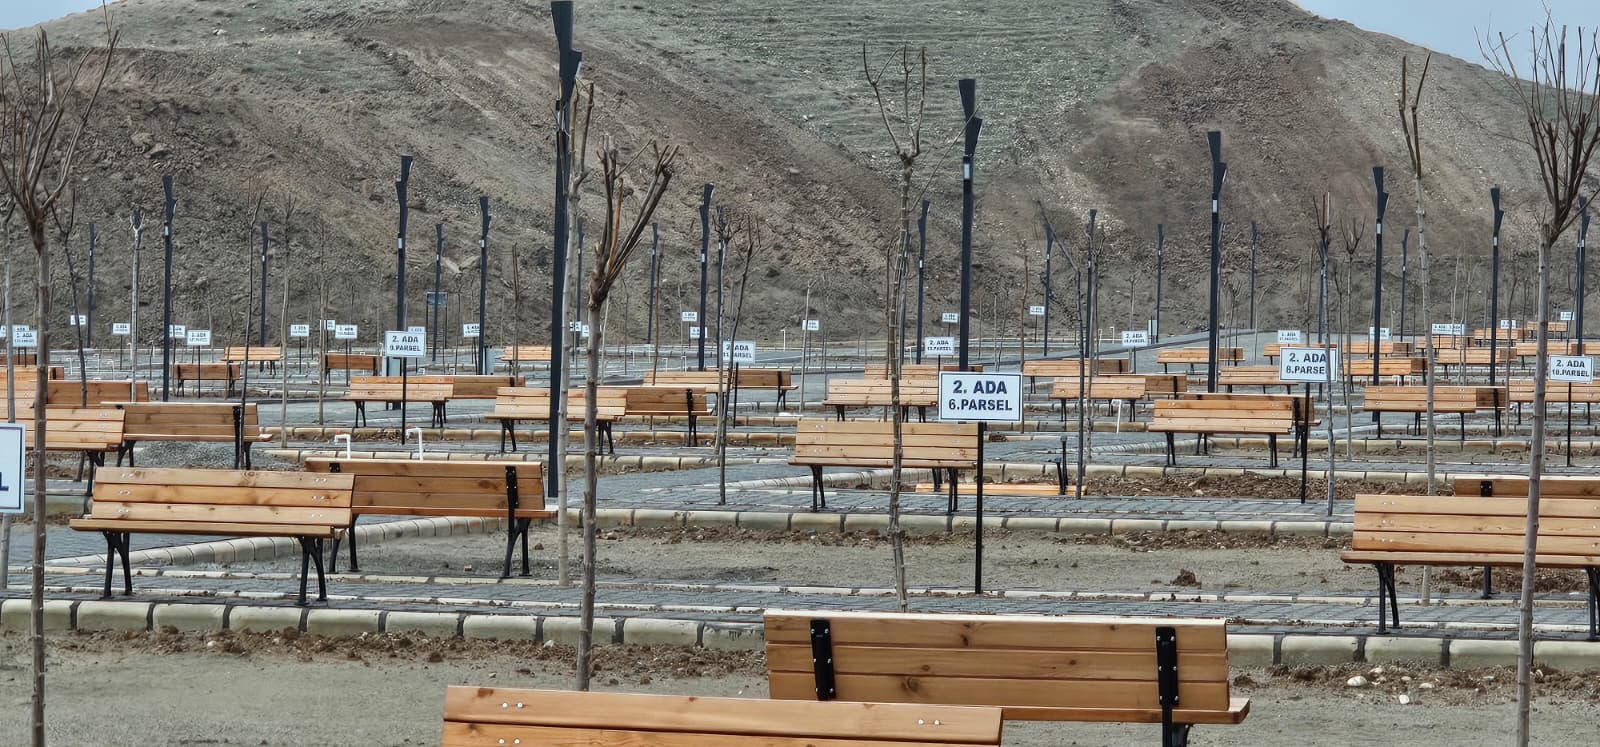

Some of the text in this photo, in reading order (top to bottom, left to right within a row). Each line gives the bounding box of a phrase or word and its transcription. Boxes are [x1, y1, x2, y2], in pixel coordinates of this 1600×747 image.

[402, 335, 419, 343] ADA
[1289, 352, 1327, 363] 2. ADA
[1556, 359, 1585, 368] 2. ADA
[1286, 365, 1328, 374] 8.PARSE
[952, 380, 1008, 395] 2. ADA
[948, 399, 1013, 412] 6.PARSEL
